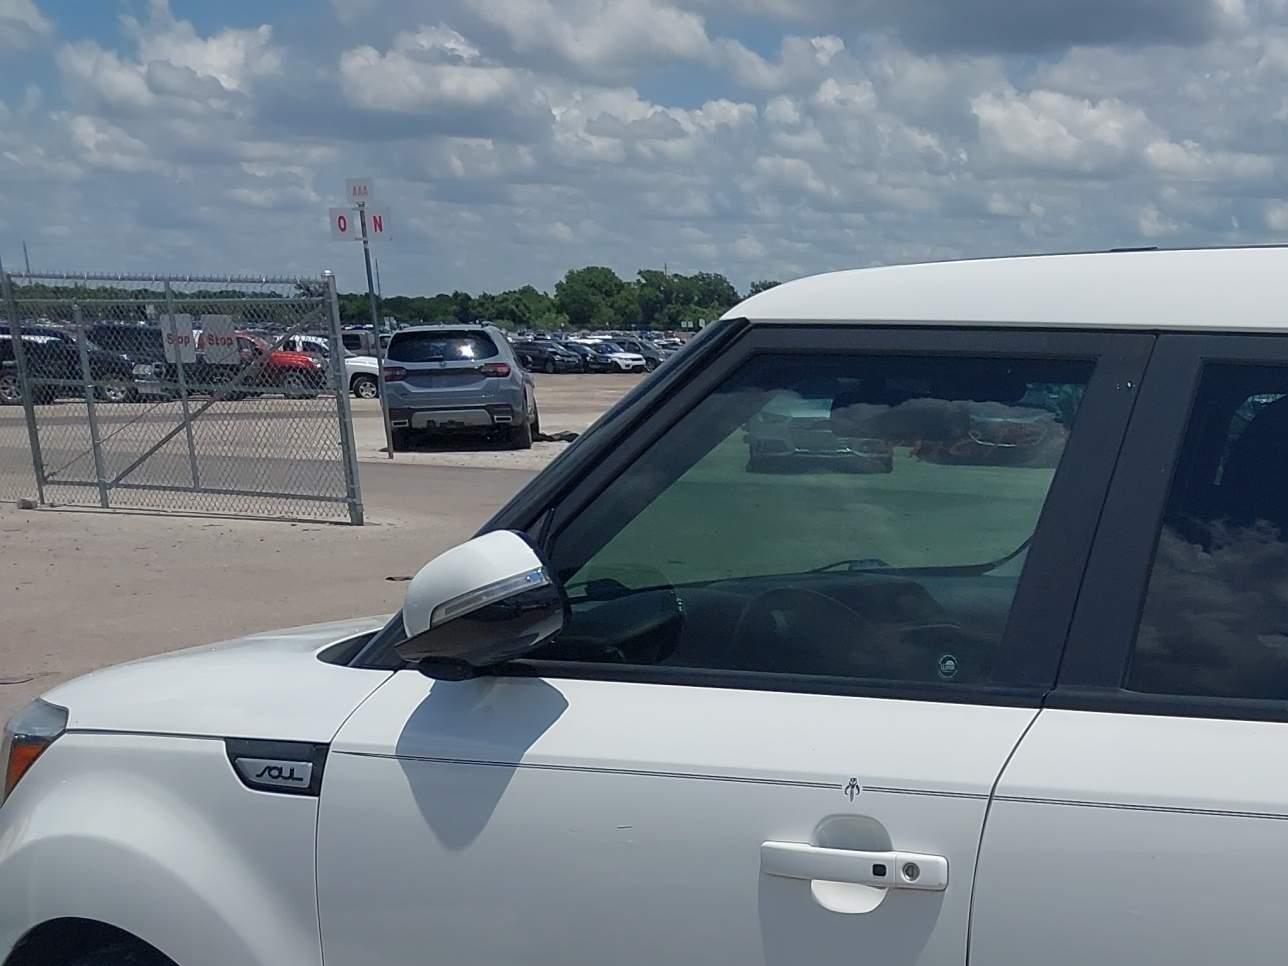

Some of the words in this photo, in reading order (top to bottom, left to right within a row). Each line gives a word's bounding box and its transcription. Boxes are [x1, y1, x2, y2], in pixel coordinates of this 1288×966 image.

[372, 215, 383, 233] N
[166, 333, 190, 347] Sop
[207, 334, 233, 348] Stop
[256, 765, 304, 782] SOUL
